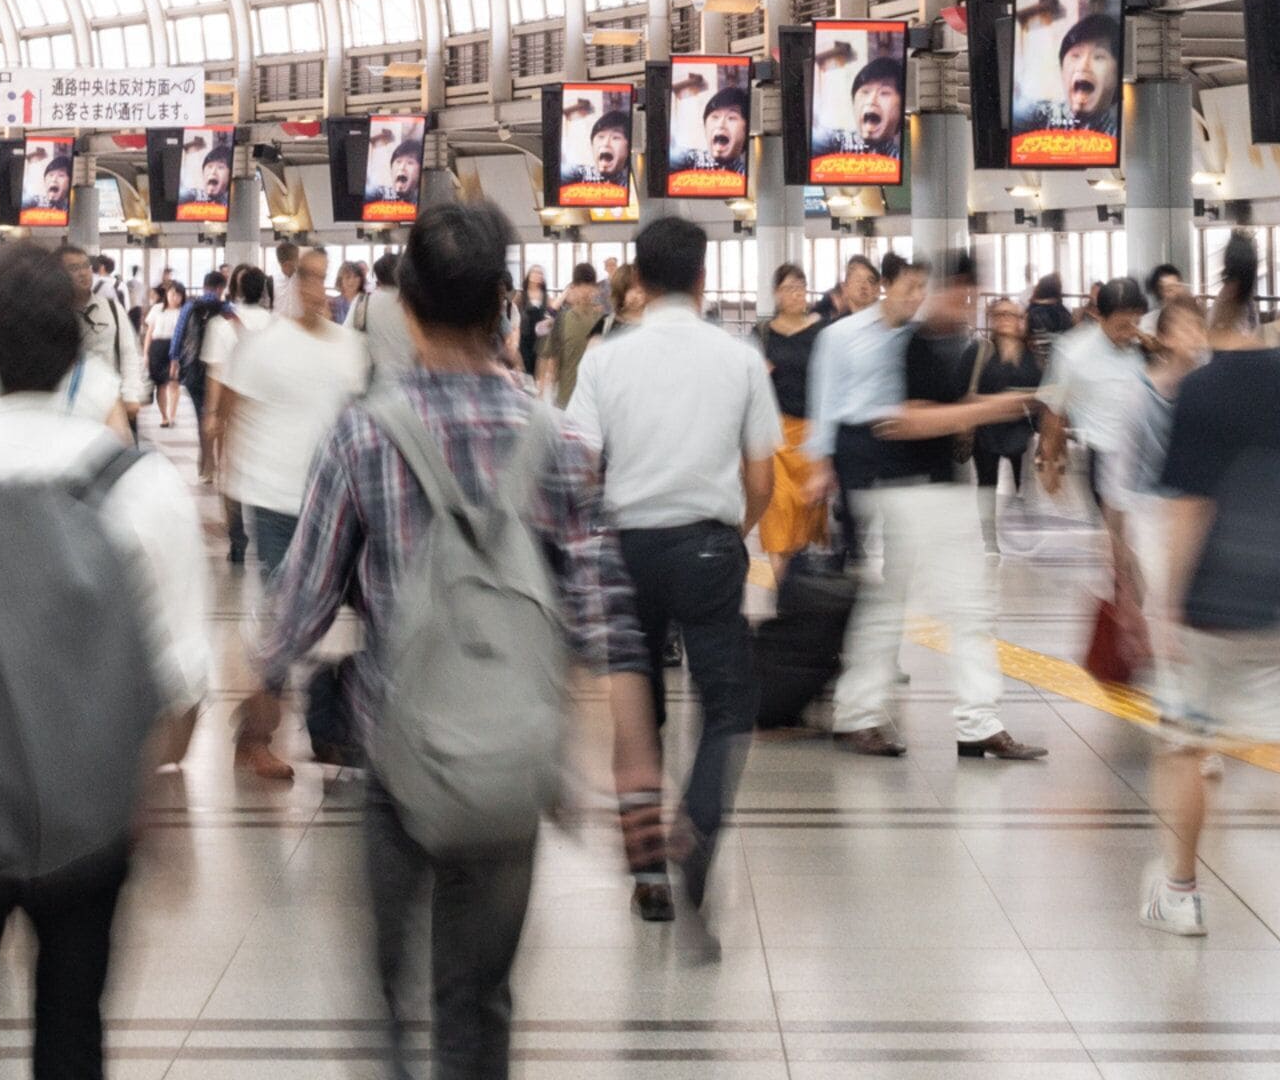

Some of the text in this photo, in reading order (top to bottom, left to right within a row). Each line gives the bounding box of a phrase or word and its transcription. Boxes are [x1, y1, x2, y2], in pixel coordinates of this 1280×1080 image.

[51, 77, 196, 97] 通路中央は反対方面への
[51, 102, 190, 121] お客さまが通行します。
